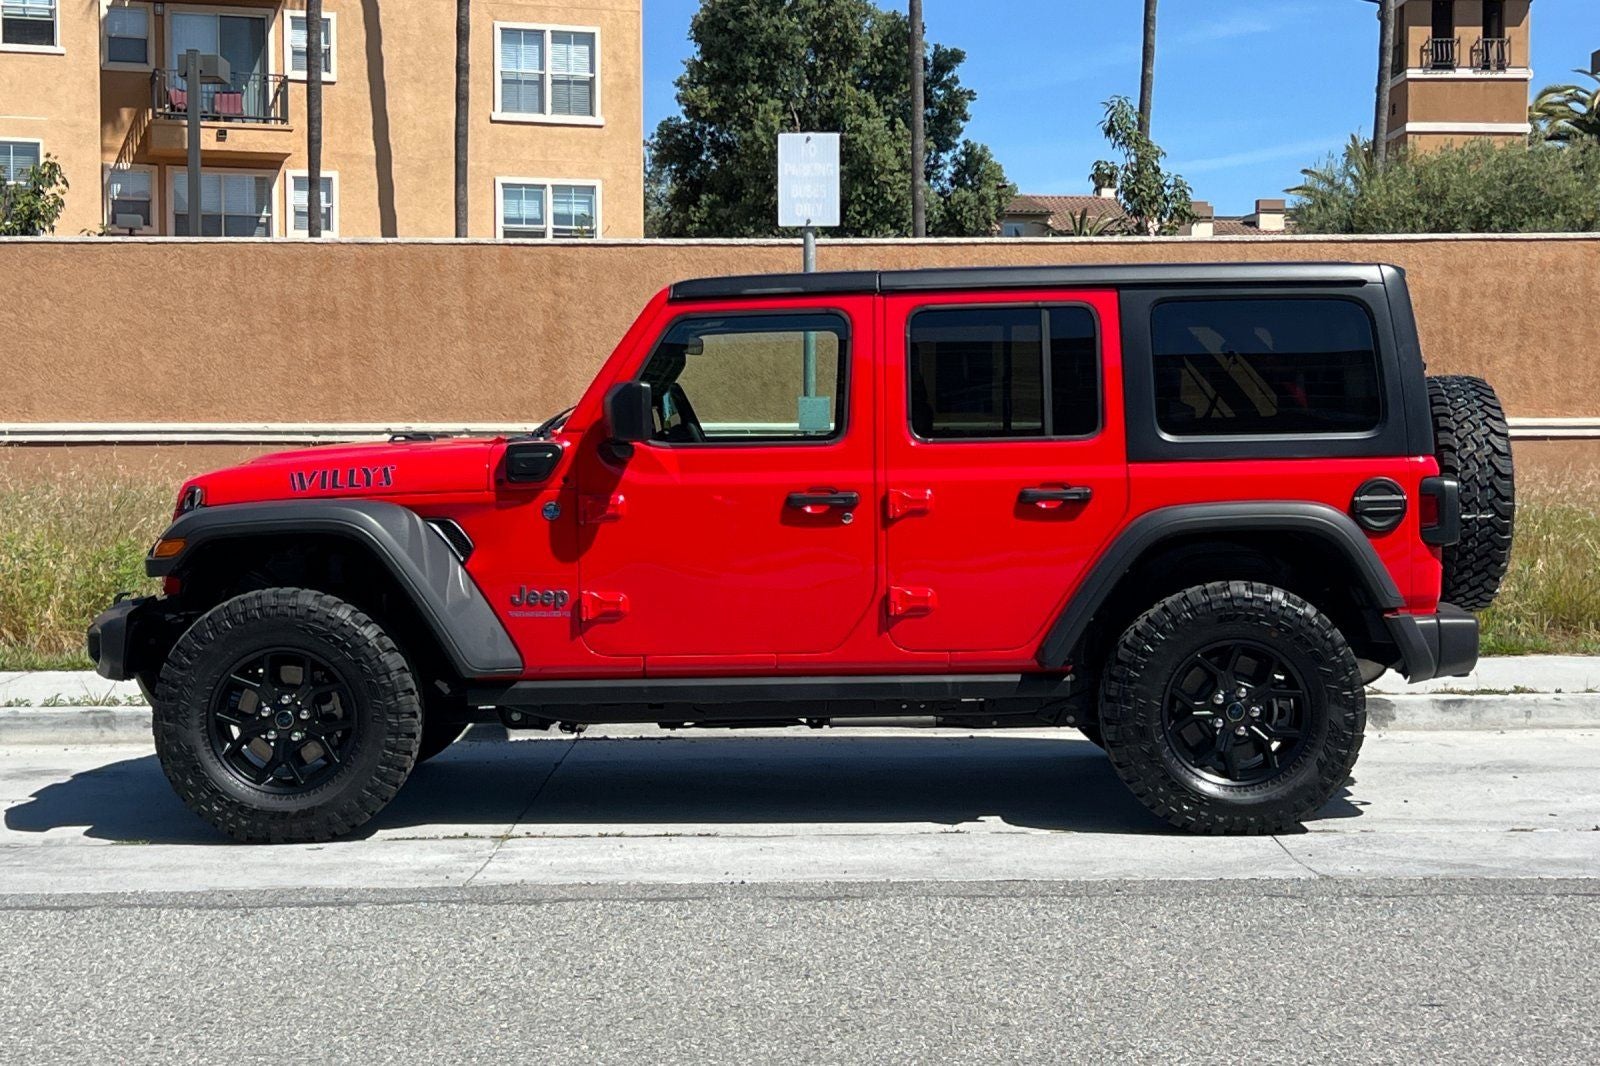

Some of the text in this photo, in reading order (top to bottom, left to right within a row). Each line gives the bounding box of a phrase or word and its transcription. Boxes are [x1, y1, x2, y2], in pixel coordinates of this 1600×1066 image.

[794, 203, 823, 217] ONLY
[289, 464, 397, 491] WILLYS
[511, 584, 570, 609] Jeep
